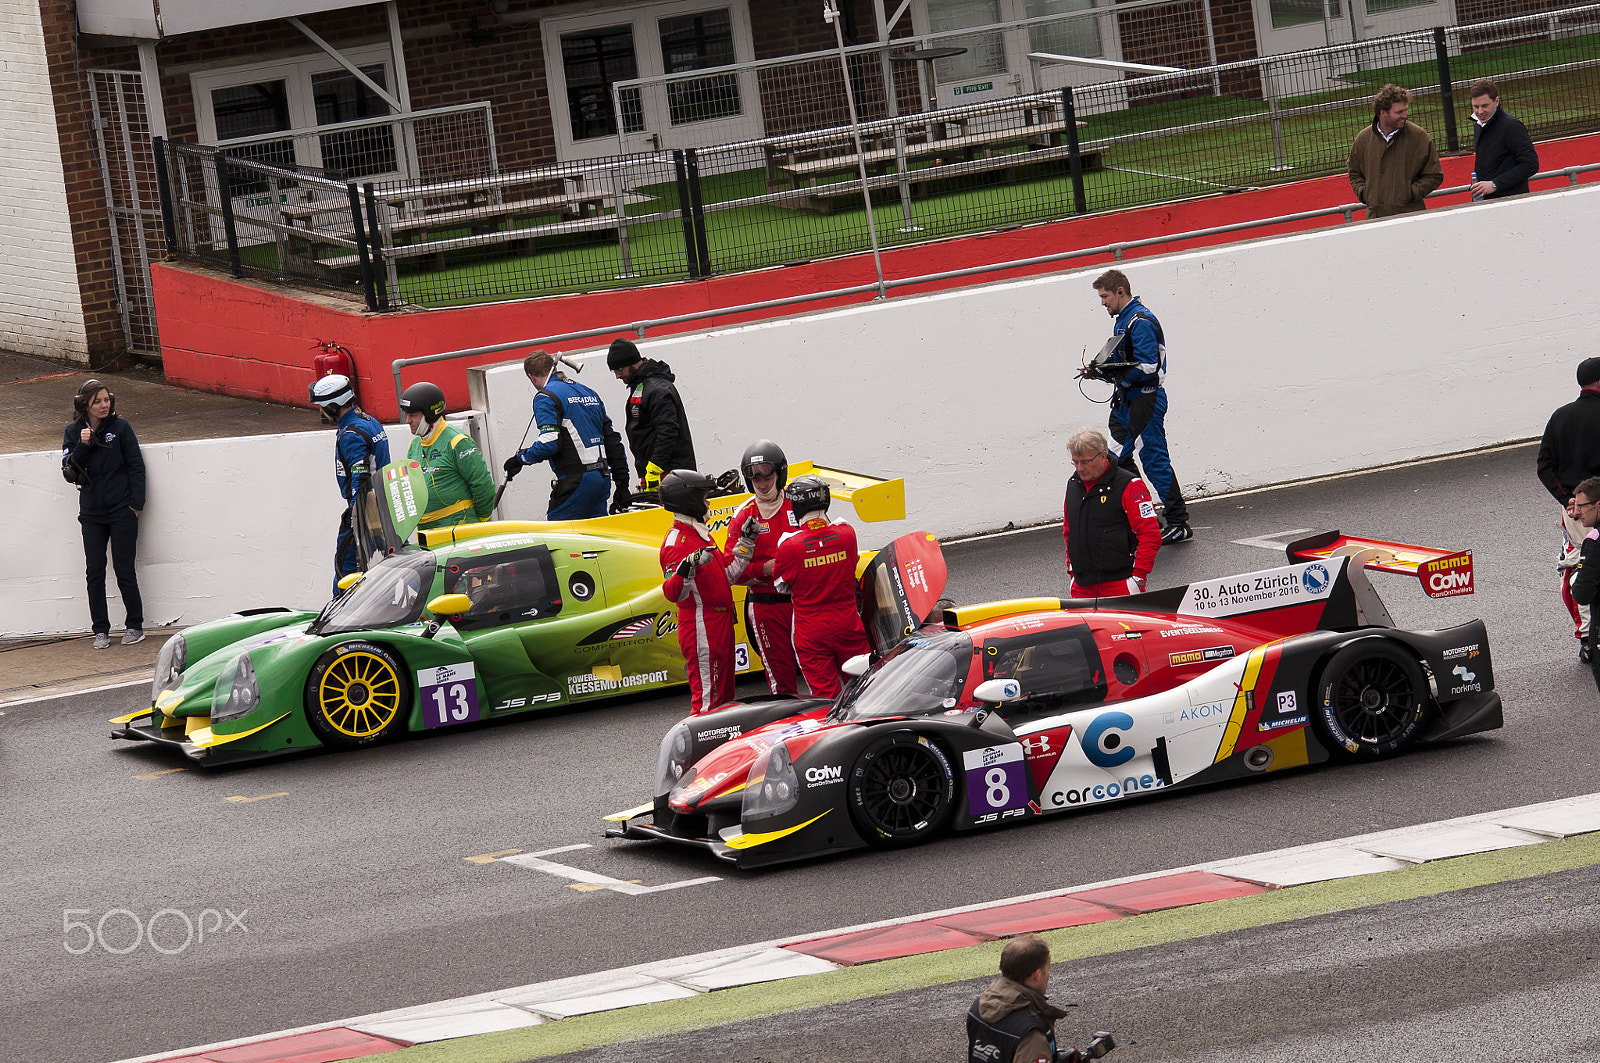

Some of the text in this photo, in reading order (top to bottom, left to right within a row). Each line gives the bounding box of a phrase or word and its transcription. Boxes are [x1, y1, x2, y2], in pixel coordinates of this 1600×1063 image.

[400, 476, 418, 517] PETERSEN
[1305, 564, 1325, 574] AUTO
[1193, 573, 1298, 601] 30. Auto Zürich
[1194, 585, 1300, 611] 10 to 13 November 2016
[348, 644, 382, 654] MICHELIN
[574, 638, 654, 654] COMPETITION
[1443, 644, 1480, 657] MOTORSPORT
[735, 648, 748, 667] 3
[442, 670, 456, 678] MANS
[567, 673, 598, 685] POWERE
[432, 683, 470, 723] 13
[495, 692, 561, 710] JS P3
[1279, 695, 1295, 709] P3
[1179, 703, 1223, 722] AKON
[1271, 716, 1307, 727] MICHELIN
[1324, 709, 1345, 742] MICHELIN
[698, 725, 741, 738] MOTORSPORT
[930, 744, 952, 776] MICHELIN
[989, 752, 1004, 761] MANS
[984, 767, 1010, 808] 8
[974, 807, 1025, 824] JS P3
